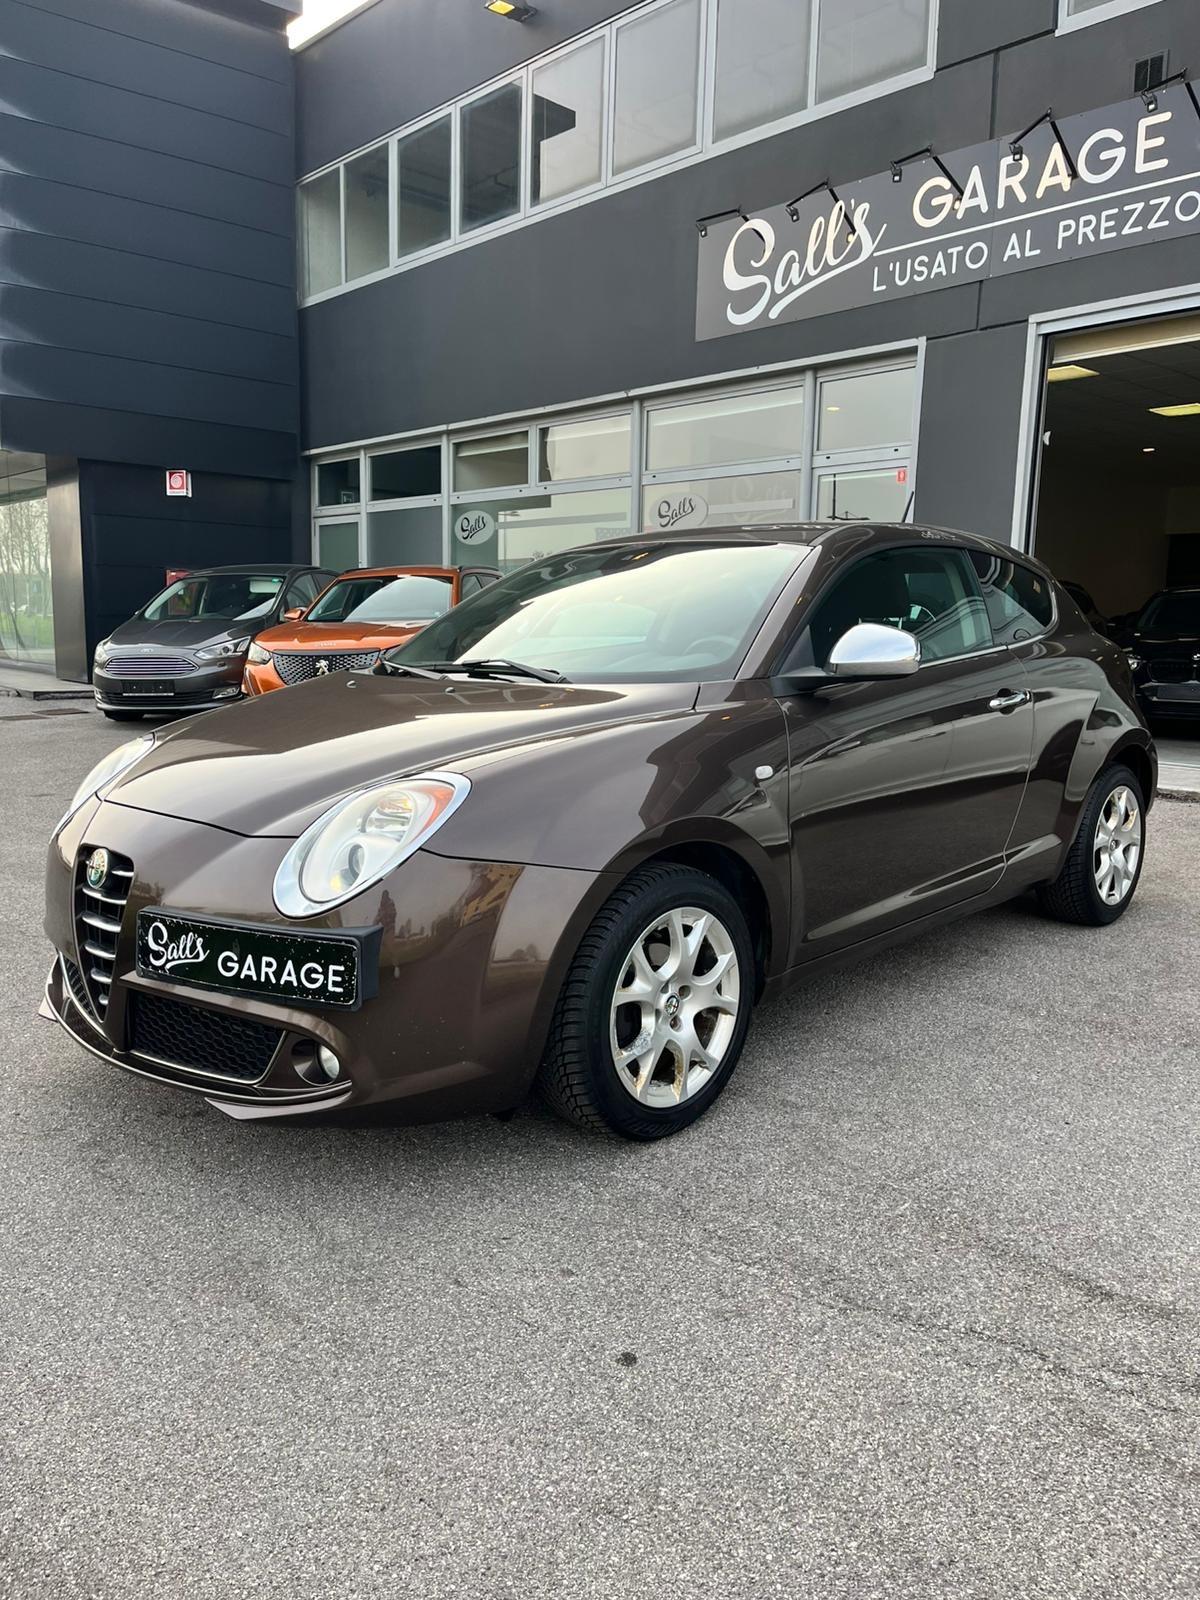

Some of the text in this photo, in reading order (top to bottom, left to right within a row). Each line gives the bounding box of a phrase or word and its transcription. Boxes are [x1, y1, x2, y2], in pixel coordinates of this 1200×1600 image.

[722, 111, 1173, 326] Sall's GARAGE
[872, 190, 1200, 293] L'USATO AL PREZZO
[217, 950, 346, 993] GARAGE
